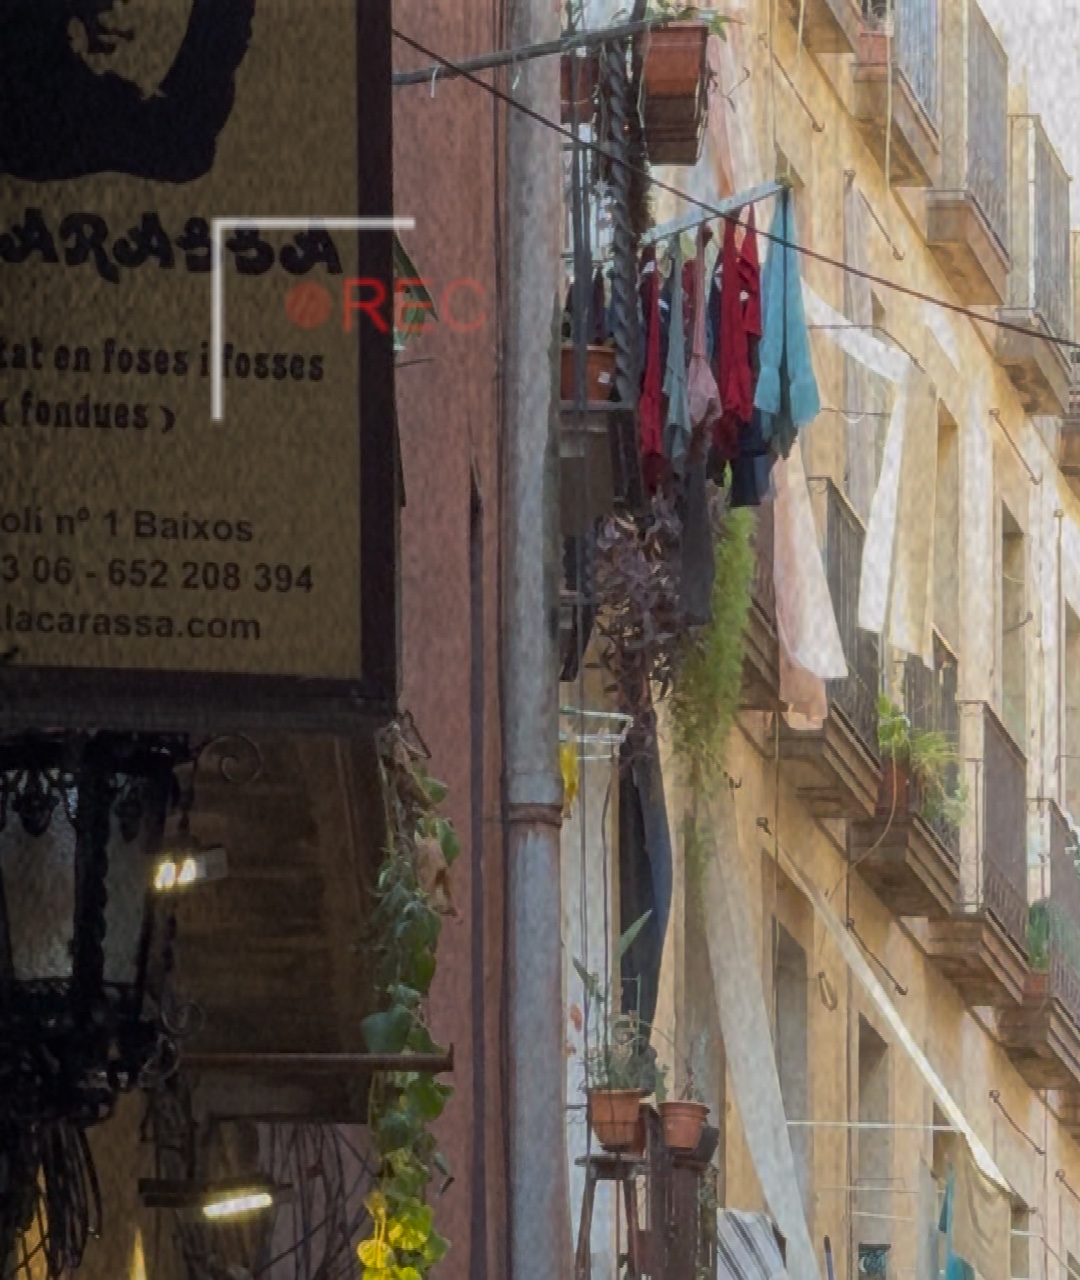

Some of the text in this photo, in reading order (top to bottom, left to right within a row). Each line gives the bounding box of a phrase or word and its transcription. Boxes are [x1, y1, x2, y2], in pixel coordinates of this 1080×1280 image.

[54, 344, 91, 373] en
[103, 337, 190, 376] foses
[103, 508, 119, 537] 1
[134, 509, 254, 543] Baixos
[32, 555, 73, 585] 06
[108, 557, 169, 589] 652
[181, 560, 242, 592] 208
[254, 562, 315, 594] 394
